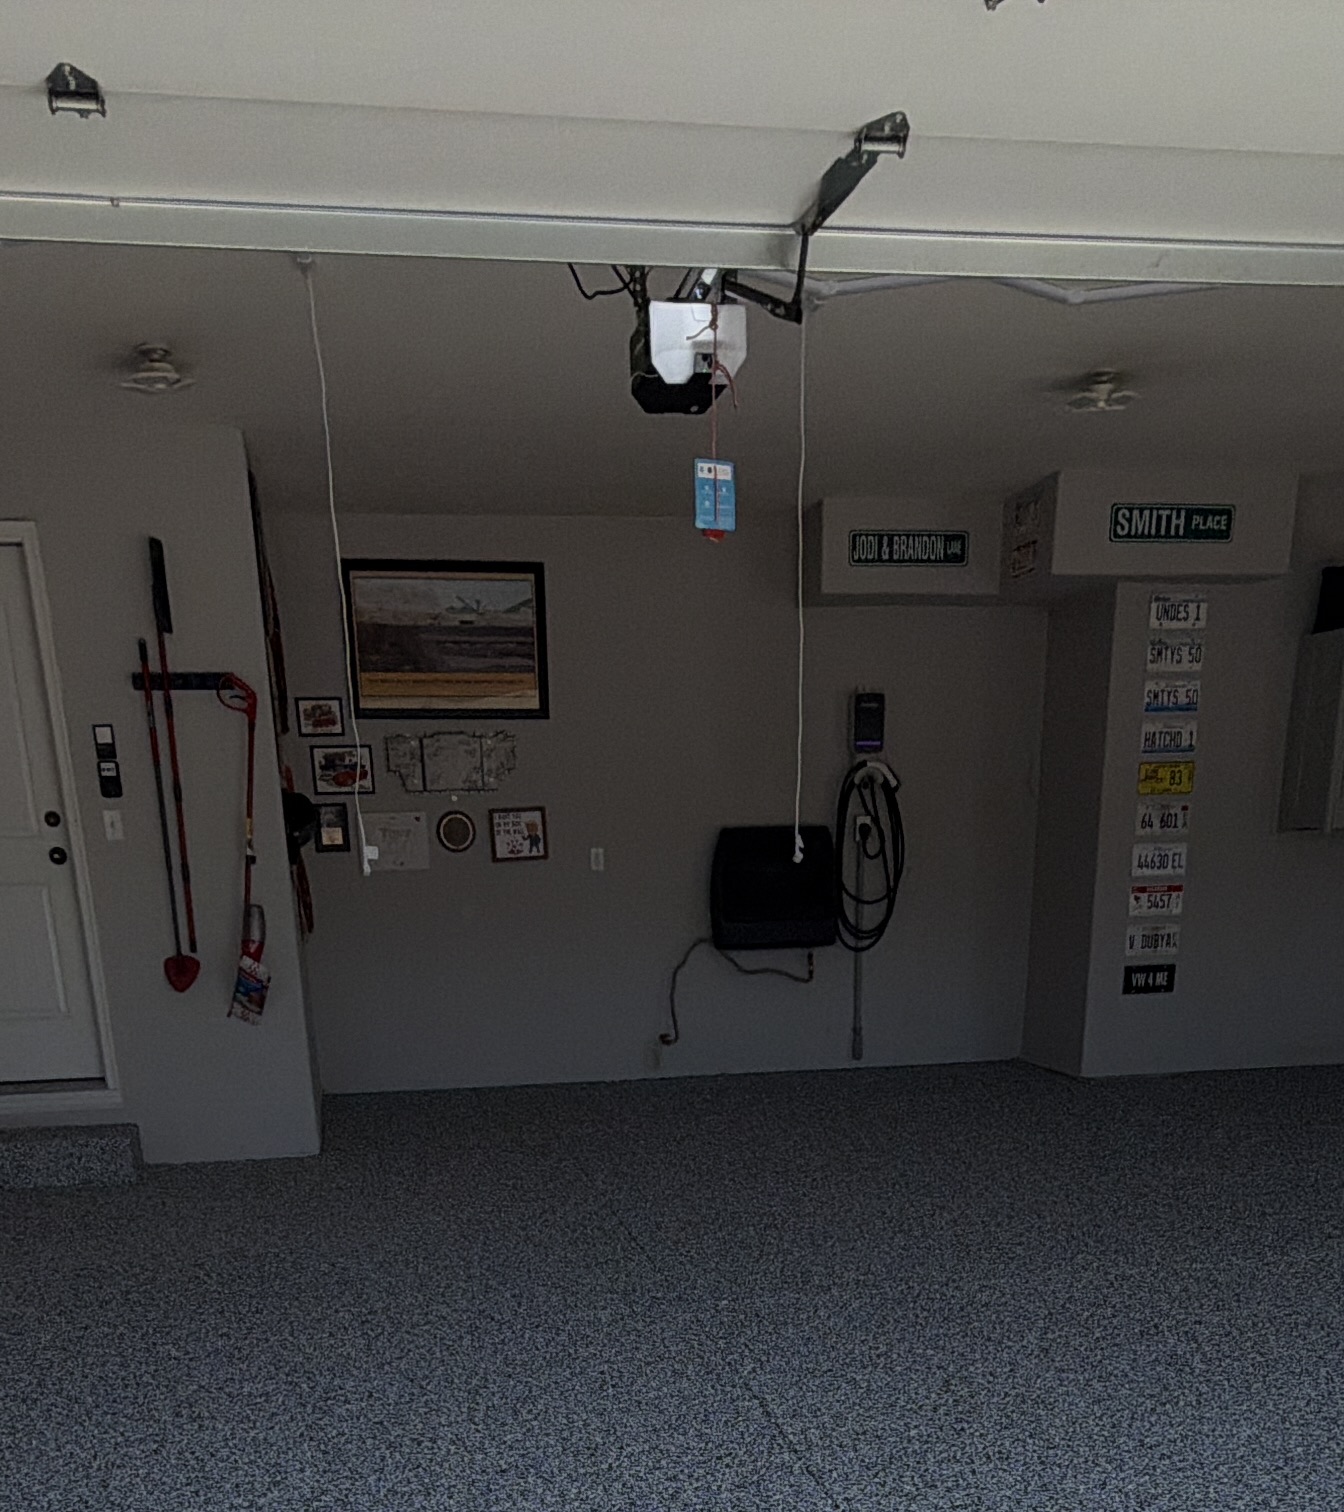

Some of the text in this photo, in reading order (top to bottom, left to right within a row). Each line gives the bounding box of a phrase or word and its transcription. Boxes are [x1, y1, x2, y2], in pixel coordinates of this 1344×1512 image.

[1116, 508, 1228, 536] SMITH PLACE
[853, 535, 878, 560] JODI
[881, 535, 889, 560] &
[893, 535, 945, 560] BRANDON
[1155, 603, 1190, 622] UNDES
